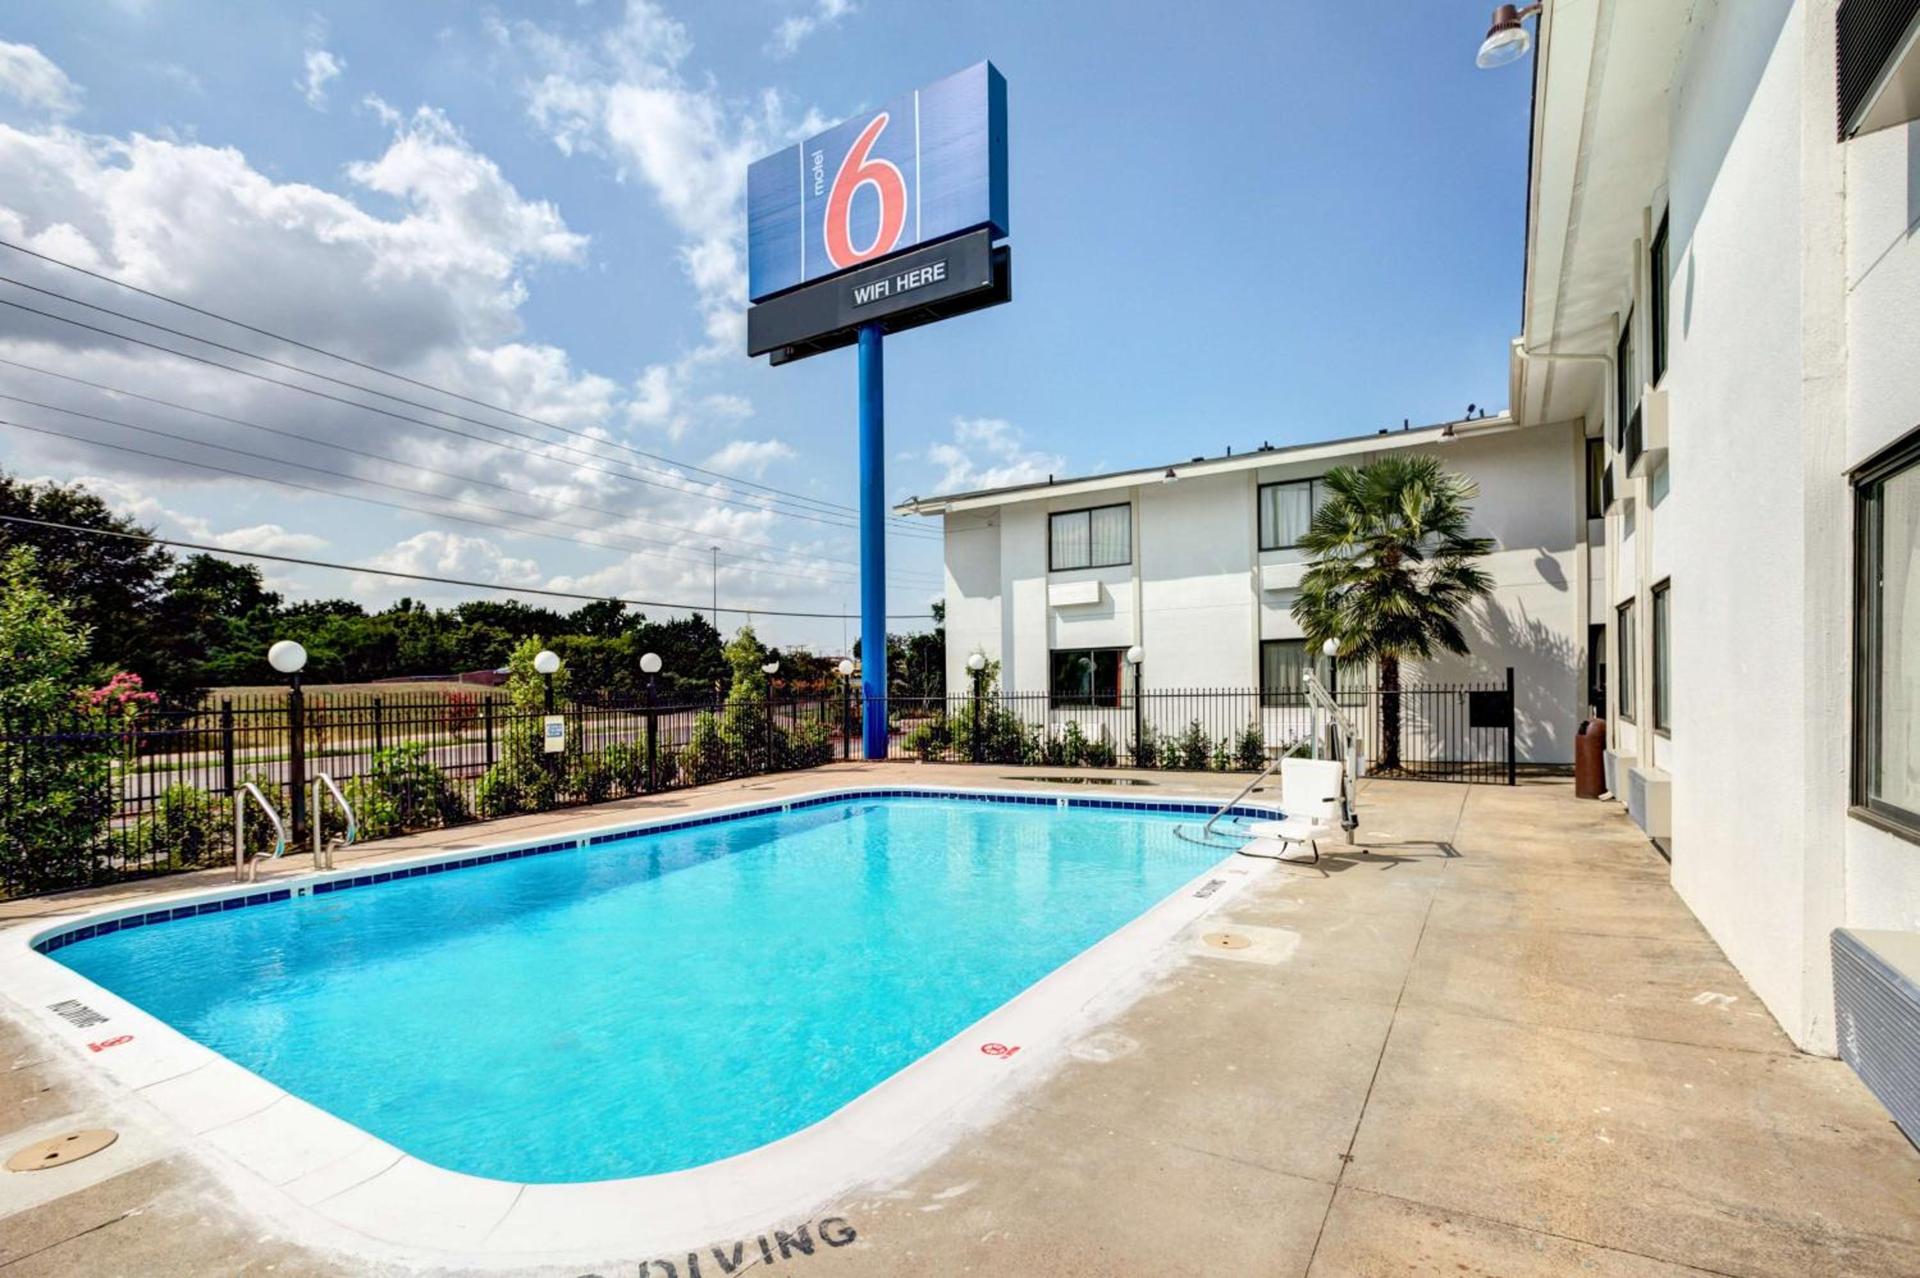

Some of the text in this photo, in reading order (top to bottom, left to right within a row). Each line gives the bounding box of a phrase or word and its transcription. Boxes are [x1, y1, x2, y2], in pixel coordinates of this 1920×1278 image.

[811, 150, 825, 196] motel
[824, 112, 907, 269] 6
[854, 262, 946, 305] WIFI HERE
